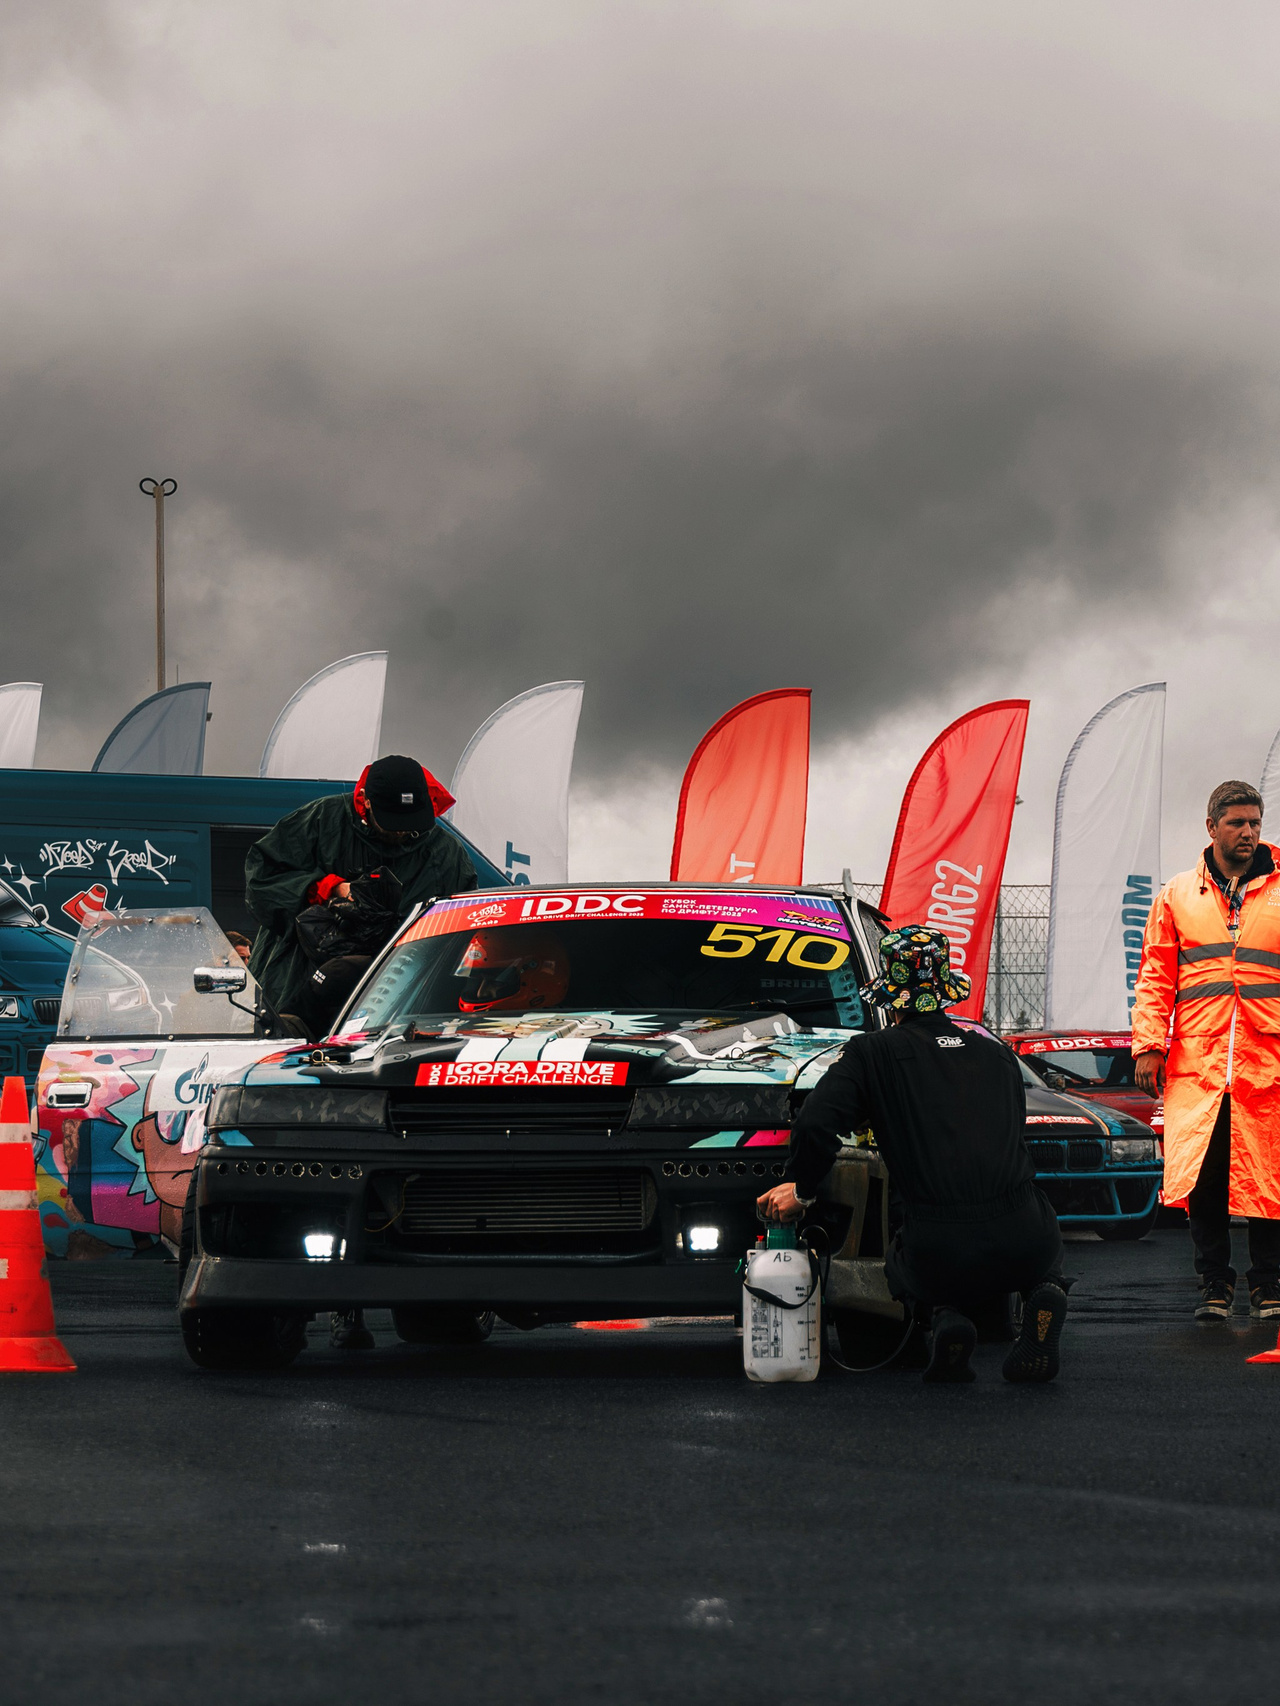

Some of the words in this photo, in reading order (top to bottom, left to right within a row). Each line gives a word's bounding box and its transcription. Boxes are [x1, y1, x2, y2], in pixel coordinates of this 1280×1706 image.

[521, 895, 646, 917] IDDC
[662, 903, 758, 914] САНКТ-ПЕТЕРБУРГА
[700, 922, 850, 971] 510
[760, 978, 828, 988] BRIDE
[936, 1036, 963, 1047] OMP
[1051, 1038, 1105, 1049] IDDC
[446, 1062, 528, 1075] IGORA
[536, 1062, 615, 1075] DRIVE
[428, 1064, 443, 1085] IDDC
[444, 1074, 499, 1085] DRIFT
[502, 1074, 613, 1085] CHALLENGE
